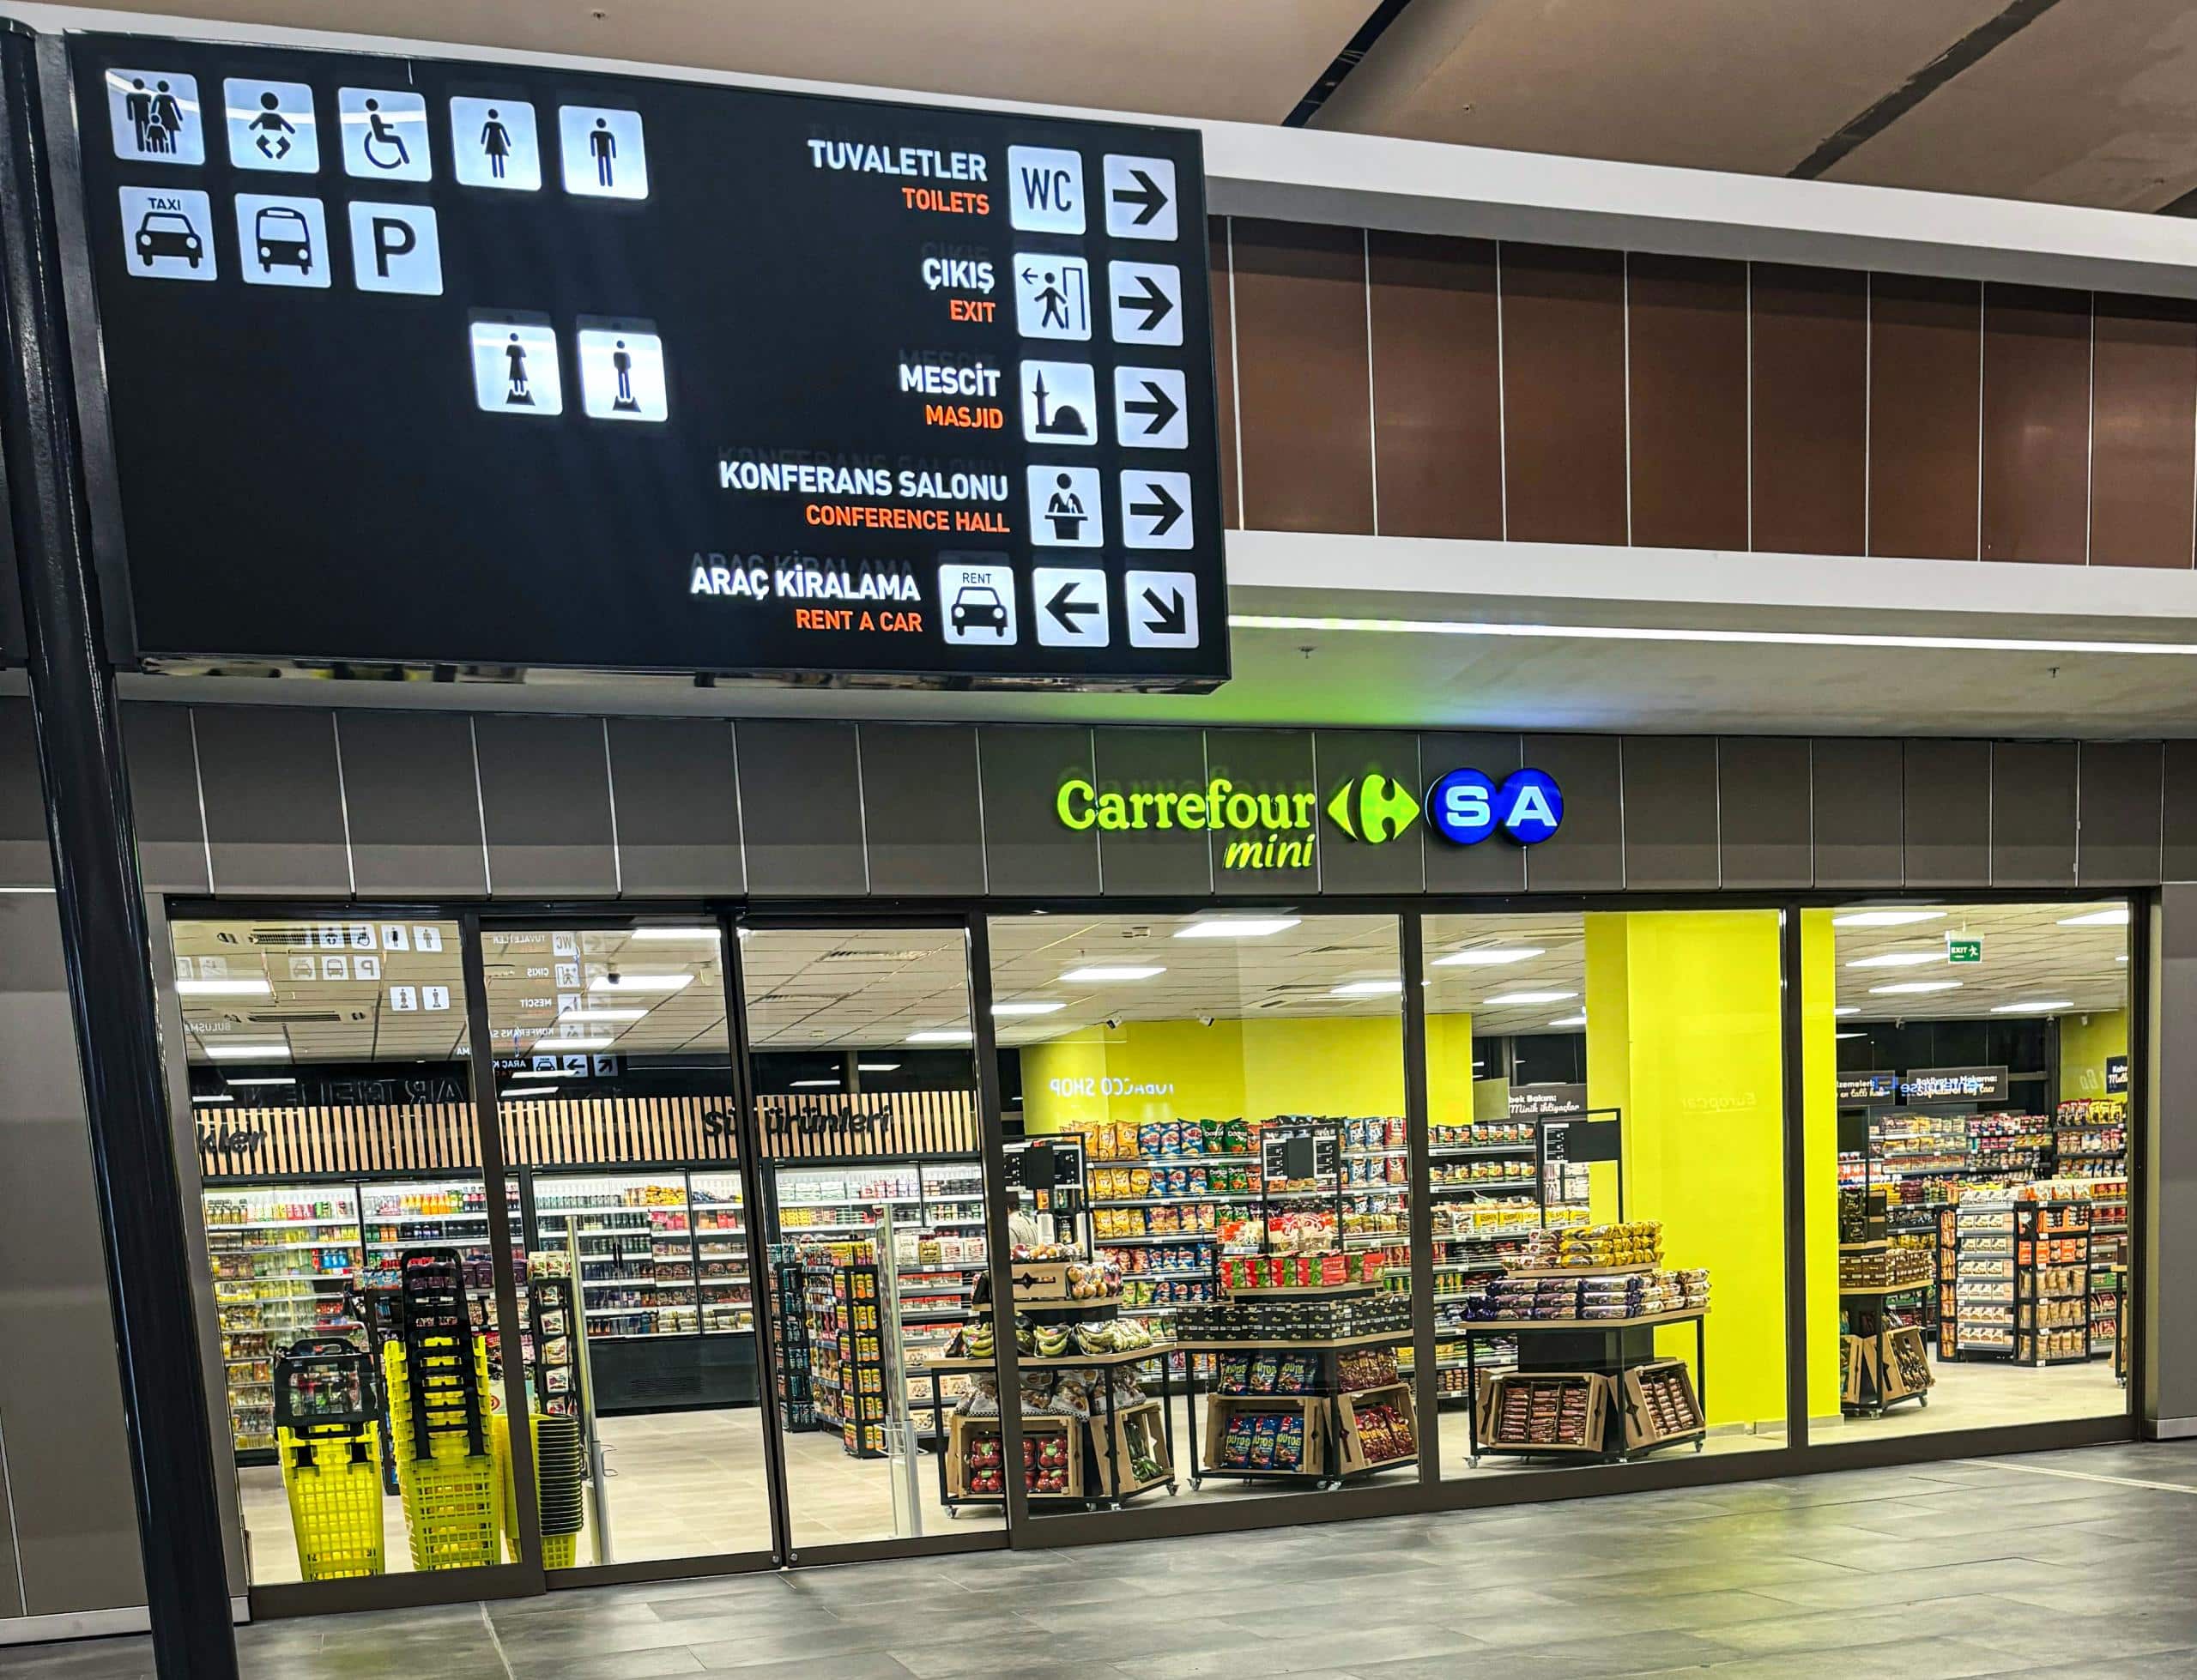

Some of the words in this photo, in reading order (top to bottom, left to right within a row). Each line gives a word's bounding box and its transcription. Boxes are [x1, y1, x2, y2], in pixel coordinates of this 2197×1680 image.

[808, 139, 987, 182] TUVALETLER
[148, 197, 181, 211] TAXI
[902, 187, 990, 215] TOILETS
[1022, 167, 1072, 212] WC
[372, 217, 416, 277] P
[923, 258, 996, 293] ÇIKIŞ
[950, 299, 996, 322] EXIT
[899, 363, 1001, 397] MESCİT
[925, 405, 1003, 430] MASJID
[719, 460, 892, 496] KONFERANS
[899, 470, 1008, 501] SALONU
[805, 504, 949, 531] CONFERENCE
[956, 511, 1010, 533] HALL
[691, 566, 769, 601] ARAÇ
[775, 565, 921, 601] KİRALAMA
[962, 572, 992, 584] RENT
[796, 608, 853, 631] RENT
[859, 611, 875, 632] A
[880, 611, 923, 632] CAR
[1057, 778, 1316, 830] Carrefour
[1225, 834, 1314, 868] mini
[766, 1104, 891, 1134] ürünleri
